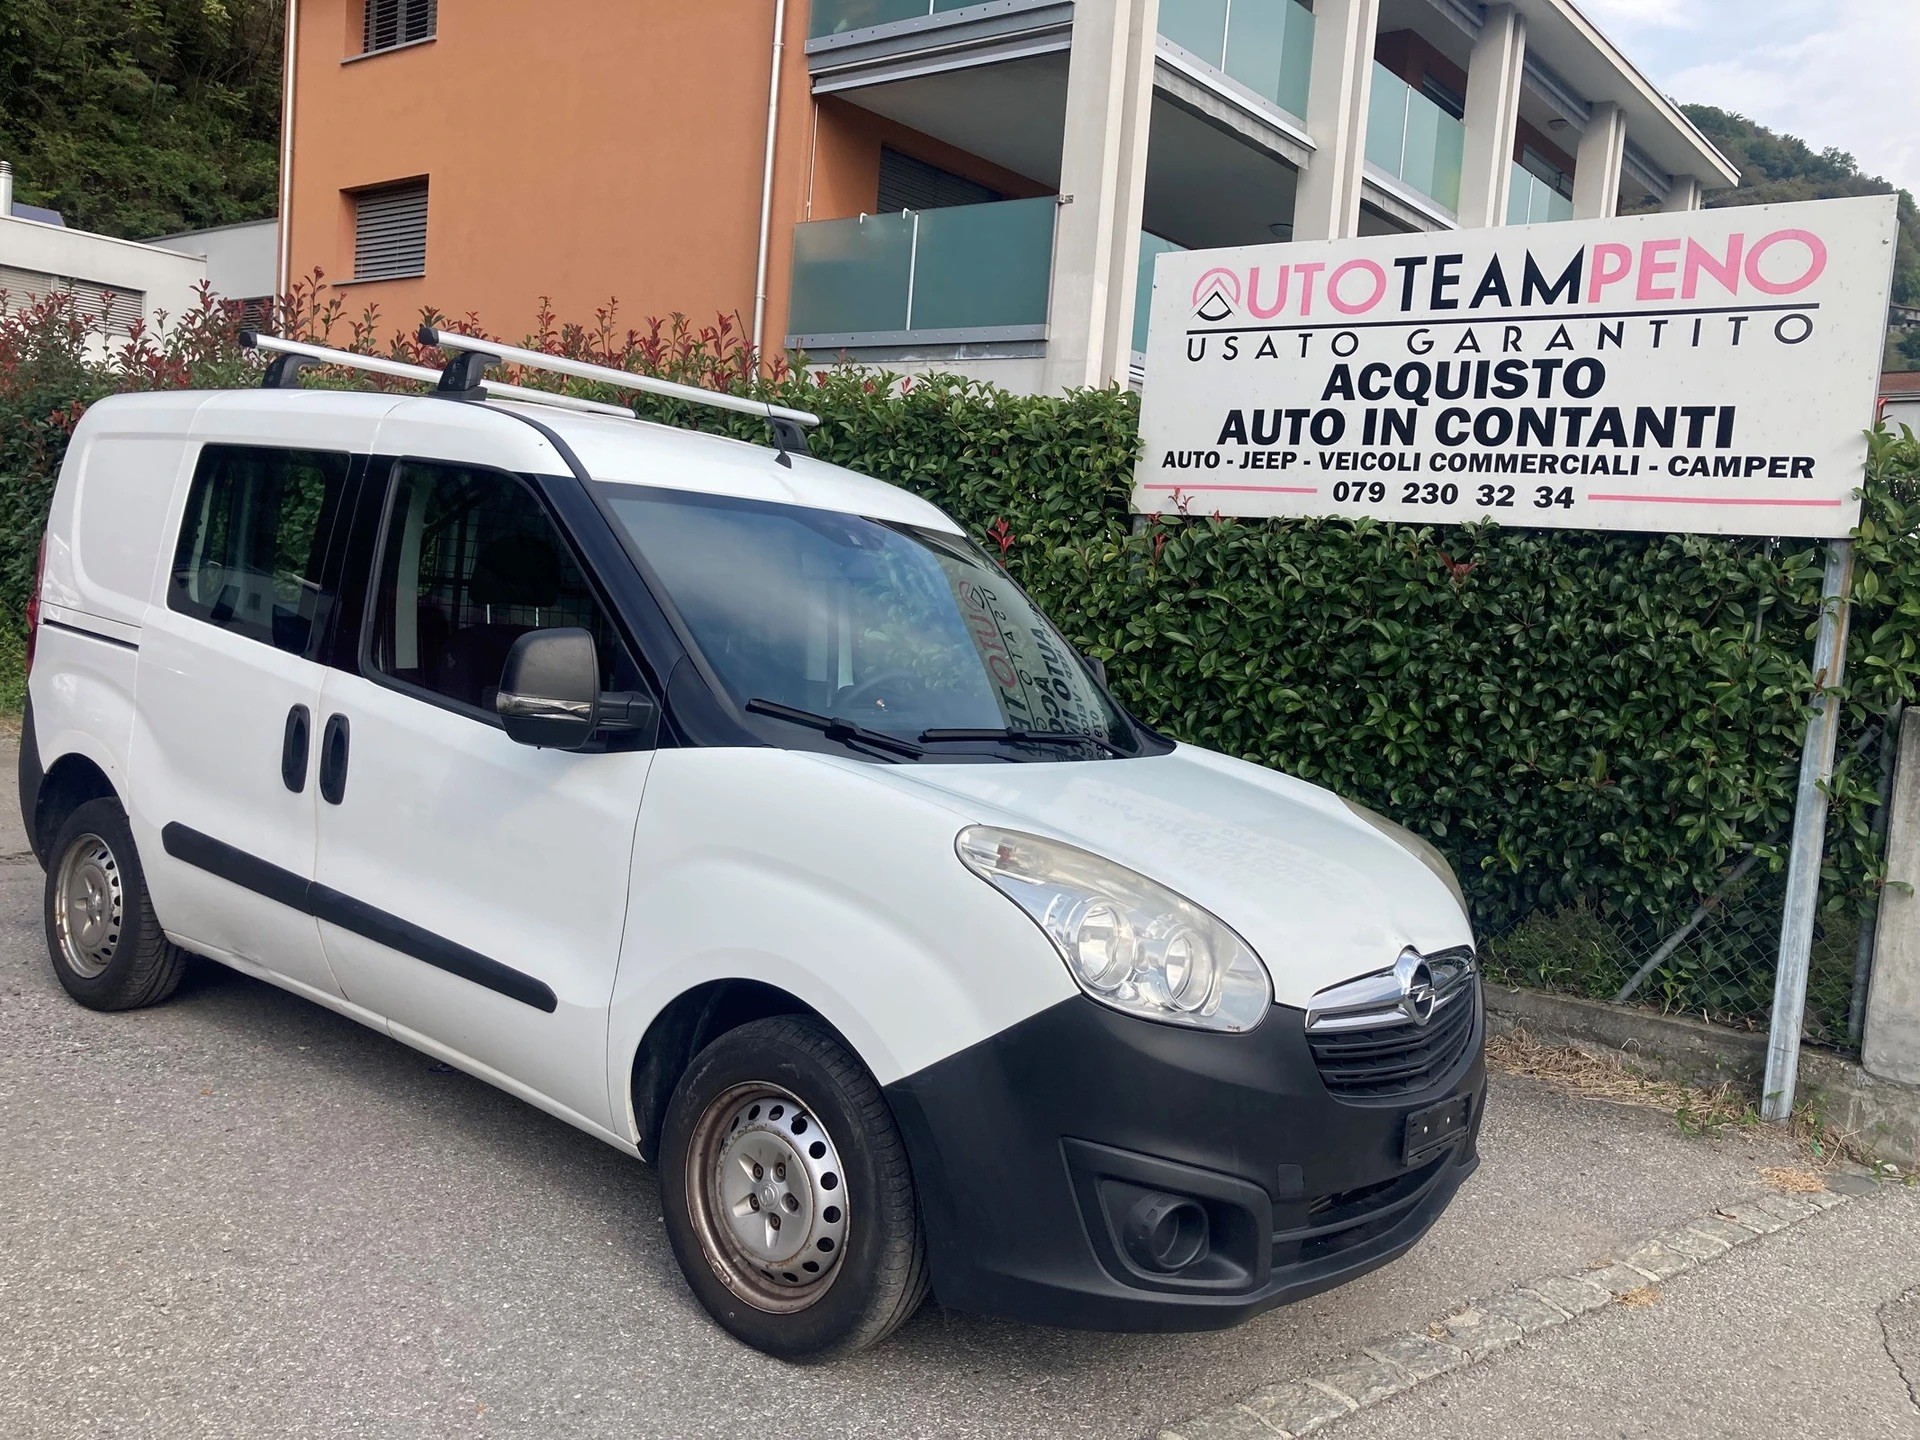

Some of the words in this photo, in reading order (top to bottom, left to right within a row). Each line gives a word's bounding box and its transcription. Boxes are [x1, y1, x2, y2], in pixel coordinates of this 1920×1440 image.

[1186, 331, 1359, 362] USATO
[1407, 313, 1814, 356] GARANTITO
[1321, 357, 1606, 406] ACQUISTO
[1217, 408, 1346, 446] AUTO
[1362, 408, 1418, 446] IN
[1435, 406, 1736, 448] CONTANTI
[1162, 451, 1221, 469] AUTO
[1239, 451, 1297, 470] JEEP
[1319, 452, 1420, 472] VEICOLI
[1429, 453, 1640, 476] COMMERCIALI
[1667, 455, 1816, 478] CAMPER
[1333, 481, 1386, 502] 079
[1402, 482, 1459, 505] 230
[1476, 484, 1516, 507] 32
[1533, 486, 1575, 509] 34
